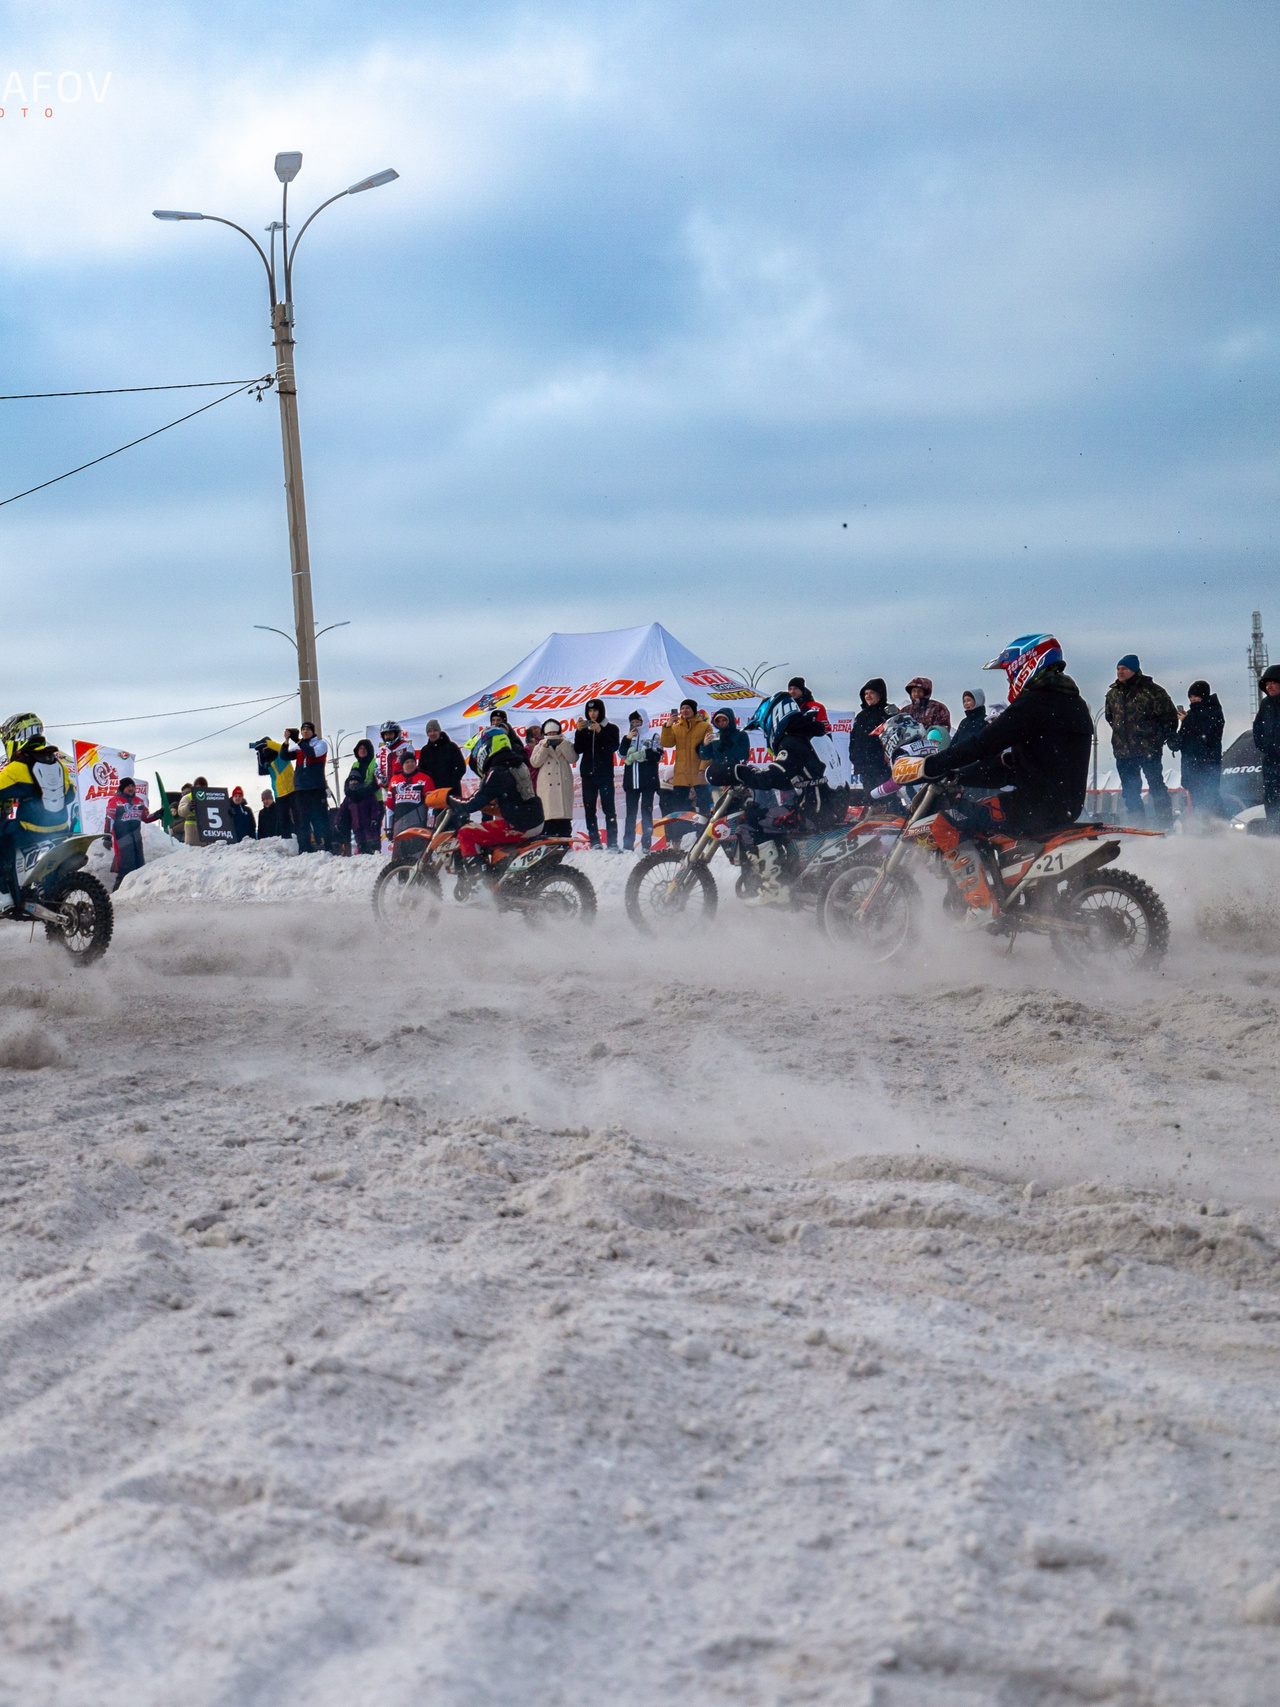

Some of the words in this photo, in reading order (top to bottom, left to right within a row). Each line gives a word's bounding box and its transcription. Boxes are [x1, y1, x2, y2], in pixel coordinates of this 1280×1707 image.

[535, 686, 573, 694] СЕТЬ
[207, 807, 223, 829] 5
[203, 830, 234, 839] СЕКУНД
[521, 847, 543, 867] 764
[1043, 853, 1064, 872] 21
